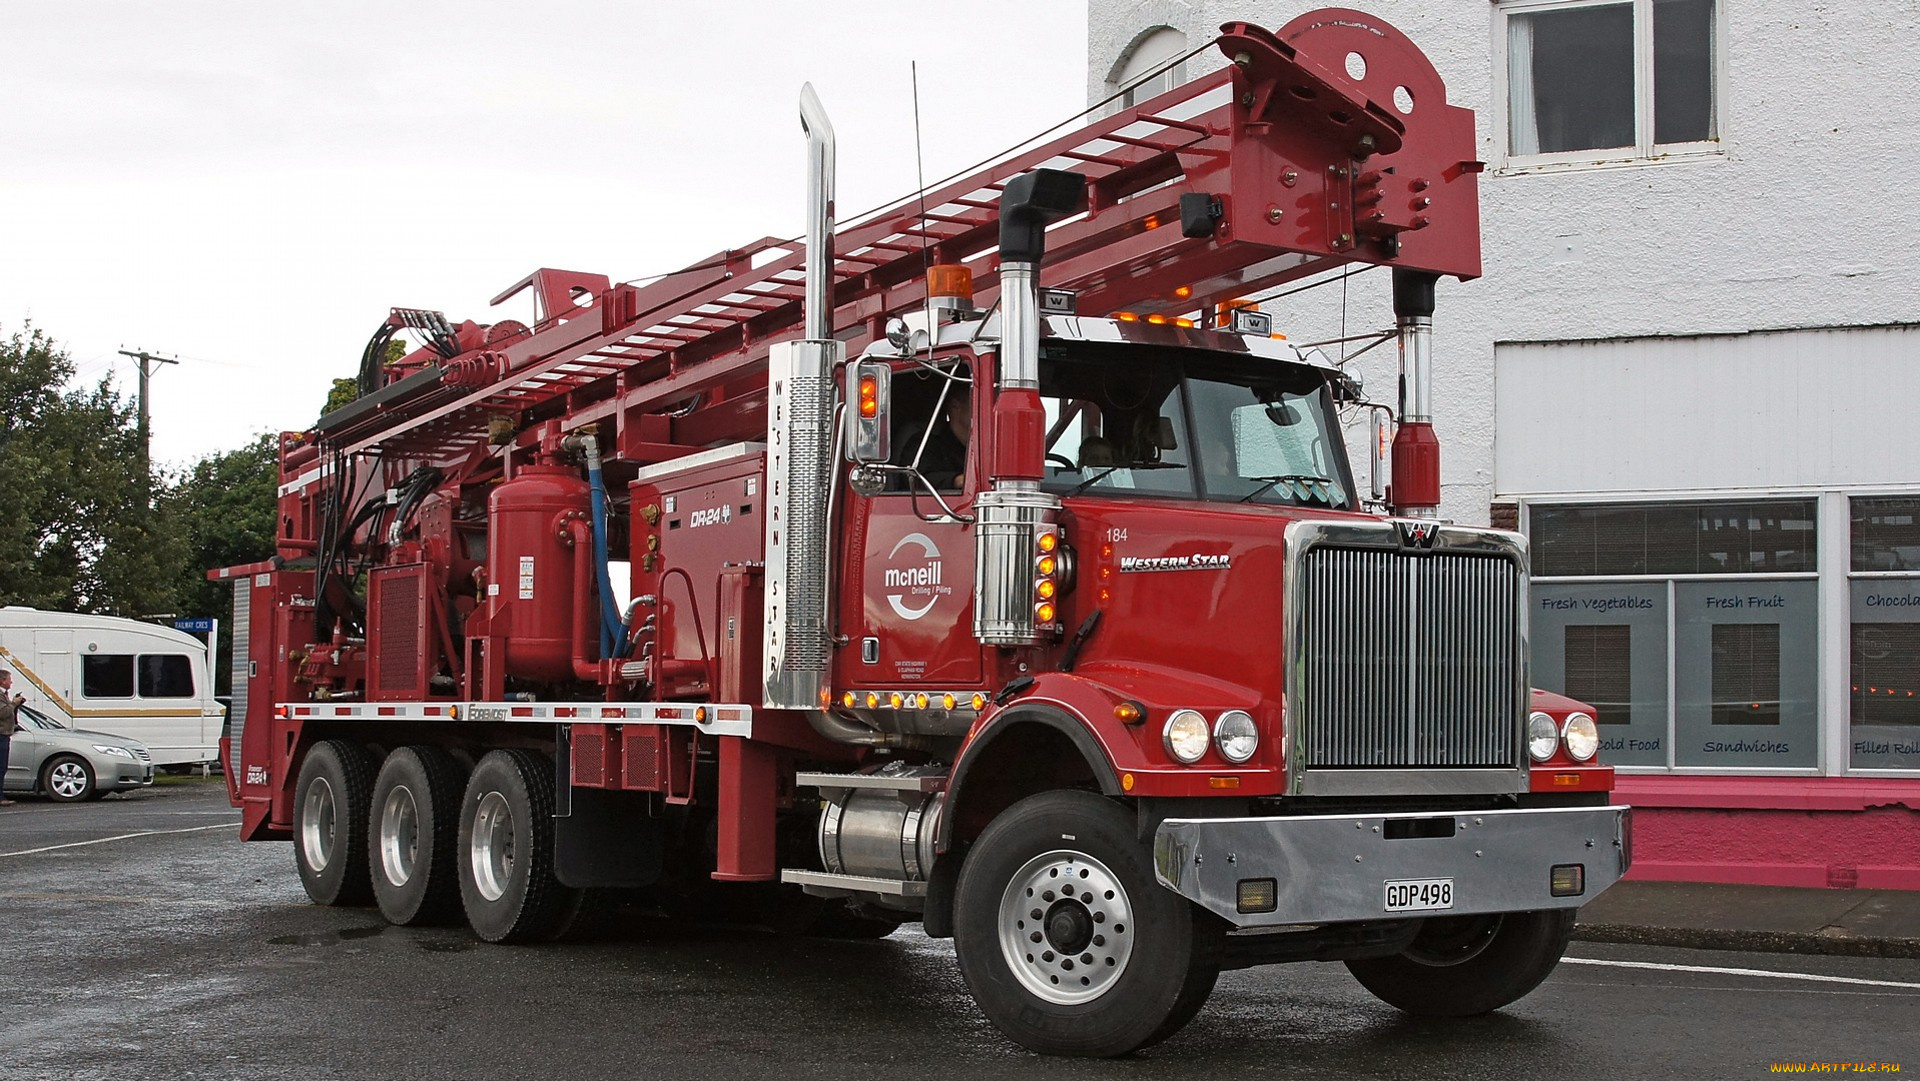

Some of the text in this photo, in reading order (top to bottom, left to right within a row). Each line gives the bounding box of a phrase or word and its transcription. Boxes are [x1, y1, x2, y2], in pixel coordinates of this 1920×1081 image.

[770, 380, 783, 672] WESTERN STAR
[1106, 527, 1128, 542] 184
[885, 561, 941, 587] mcneill
[1541, 596, 1653, 613] Fresh Vegetables
[1706, 595, 1785, 608] Fresh Fruit
[1866, 594, 1920, 607] Chocola
[1597, 737, 1660, 751] Cold Food
[1702, 740, 1789, 753] Sandwiches
[1854, 741, 1920, 754] Filled Roll
[1387, 883, 1451, 907] GDP498
